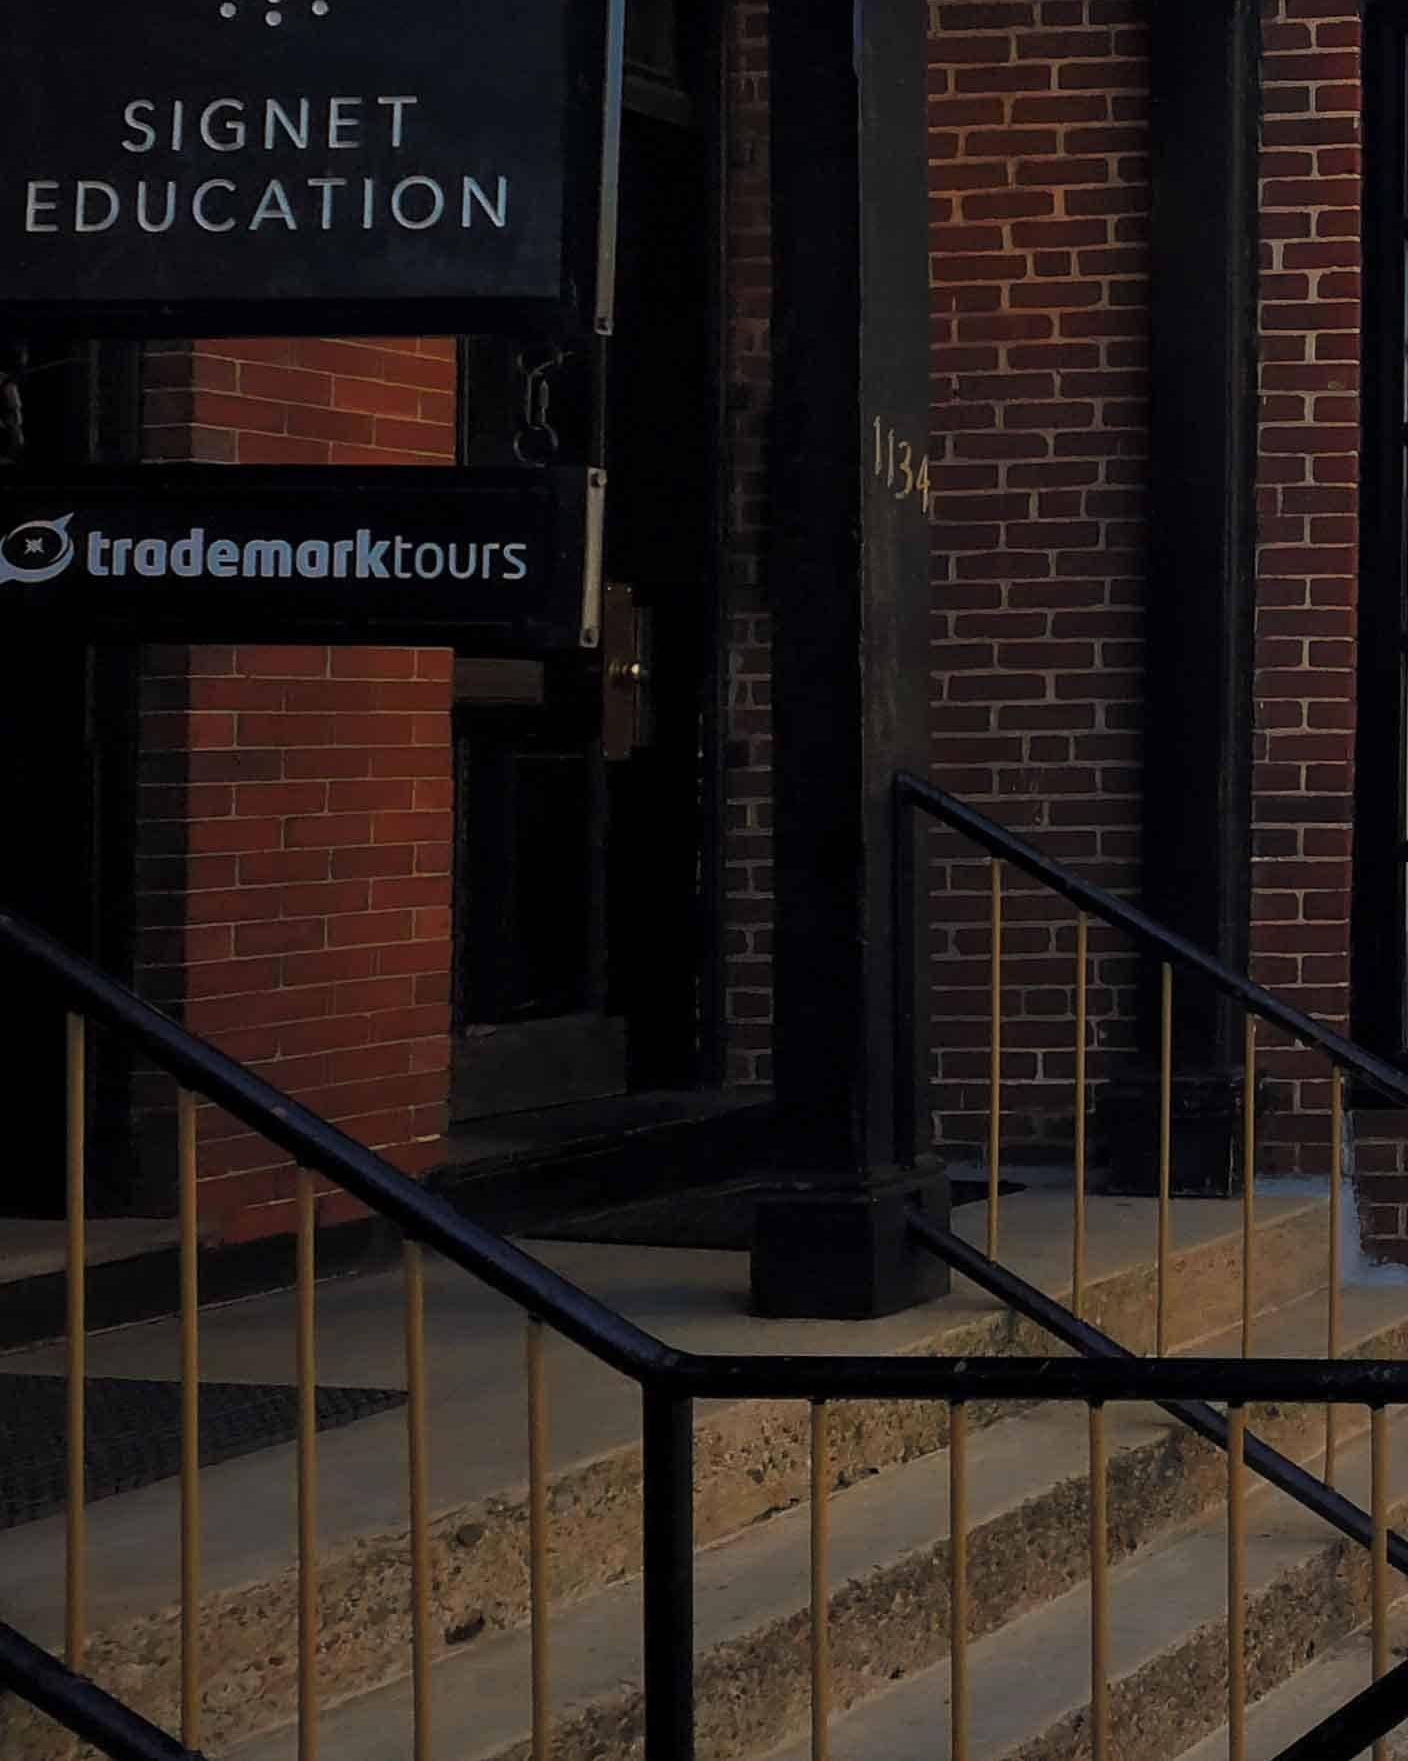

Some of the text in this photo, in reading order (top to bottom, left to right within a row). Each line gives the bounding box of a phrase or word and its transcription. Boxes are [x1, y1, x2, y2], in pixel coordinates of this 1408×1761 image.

[120, 95, 419, 154] SIGNET
[25, 175, 510, 234] EDUCATION
[872, 414, 931, 515] 1134
[87, 527, 528, 581] trademarktours
